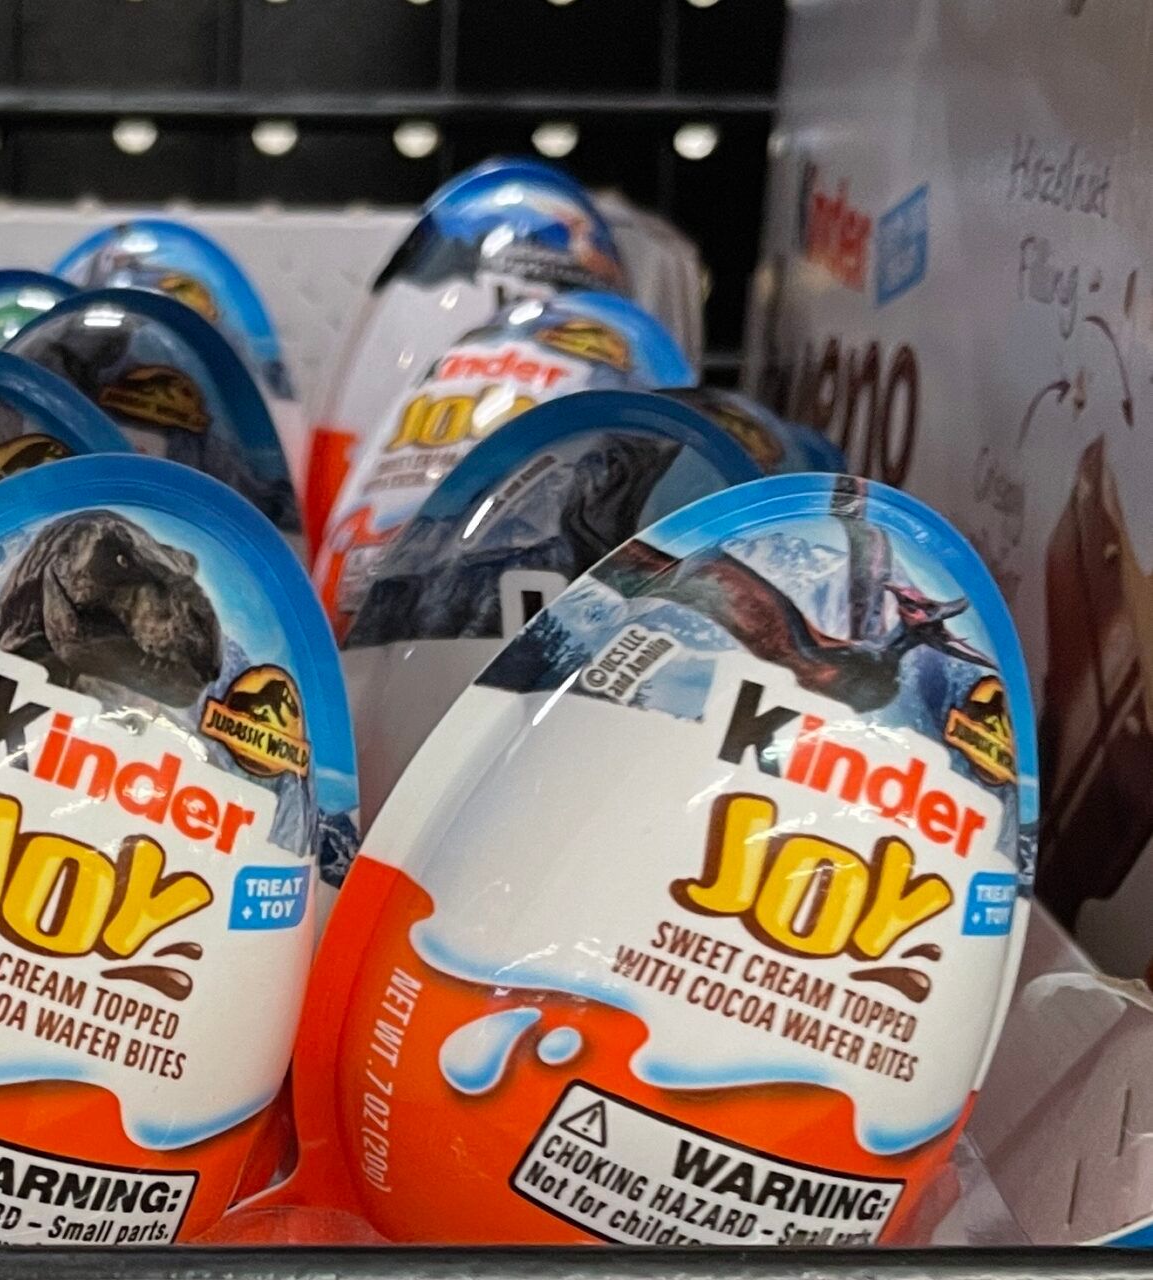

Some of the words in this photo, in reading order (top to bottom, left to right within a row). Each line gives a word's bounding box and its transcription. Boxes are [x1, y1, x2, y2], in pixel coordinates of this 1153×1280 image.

[206, 708, 266, 750] JURASSIC
[266, 733, 308, 768] WORLD
[246, 875, 304, 898] TREAT
[669, 792, 953, 961] JOY
[260, 897, 296, 920] TOY
[91, 984, 182, 1041] TOPPED
[384, 966, 423, 1027] NET
[613, 943, 682, 993] WITH
[687, 973, 776, 1033] COCOA
[782, 1010, 866, 1065] WAFER
[868, 1040, 920, 1081] BITES
[651, 921, 739, 973] SWEET
[744, 946, 837, 1005] CREAM
[839, 986, 919, 1044] TOPPED
[33, 1008, 122, 1065] WAFER
[123, 1037, 187, 1081] BITES
[370, 1018, 405, 1069] WT
[363, 1092, 391, 1132] OZ
[524, 1160, 558, 1194] Not
[573, 1185, 608, 1219] for
[543, 1133, 650, 1202] CHOKING
[650, 1183, 759, 1239] HAZARD
[672, 1138, 890, 1222] WARNING:
[48, 1214, 111, 1244] Small
[115, 1218, 169, 1245] parts.
